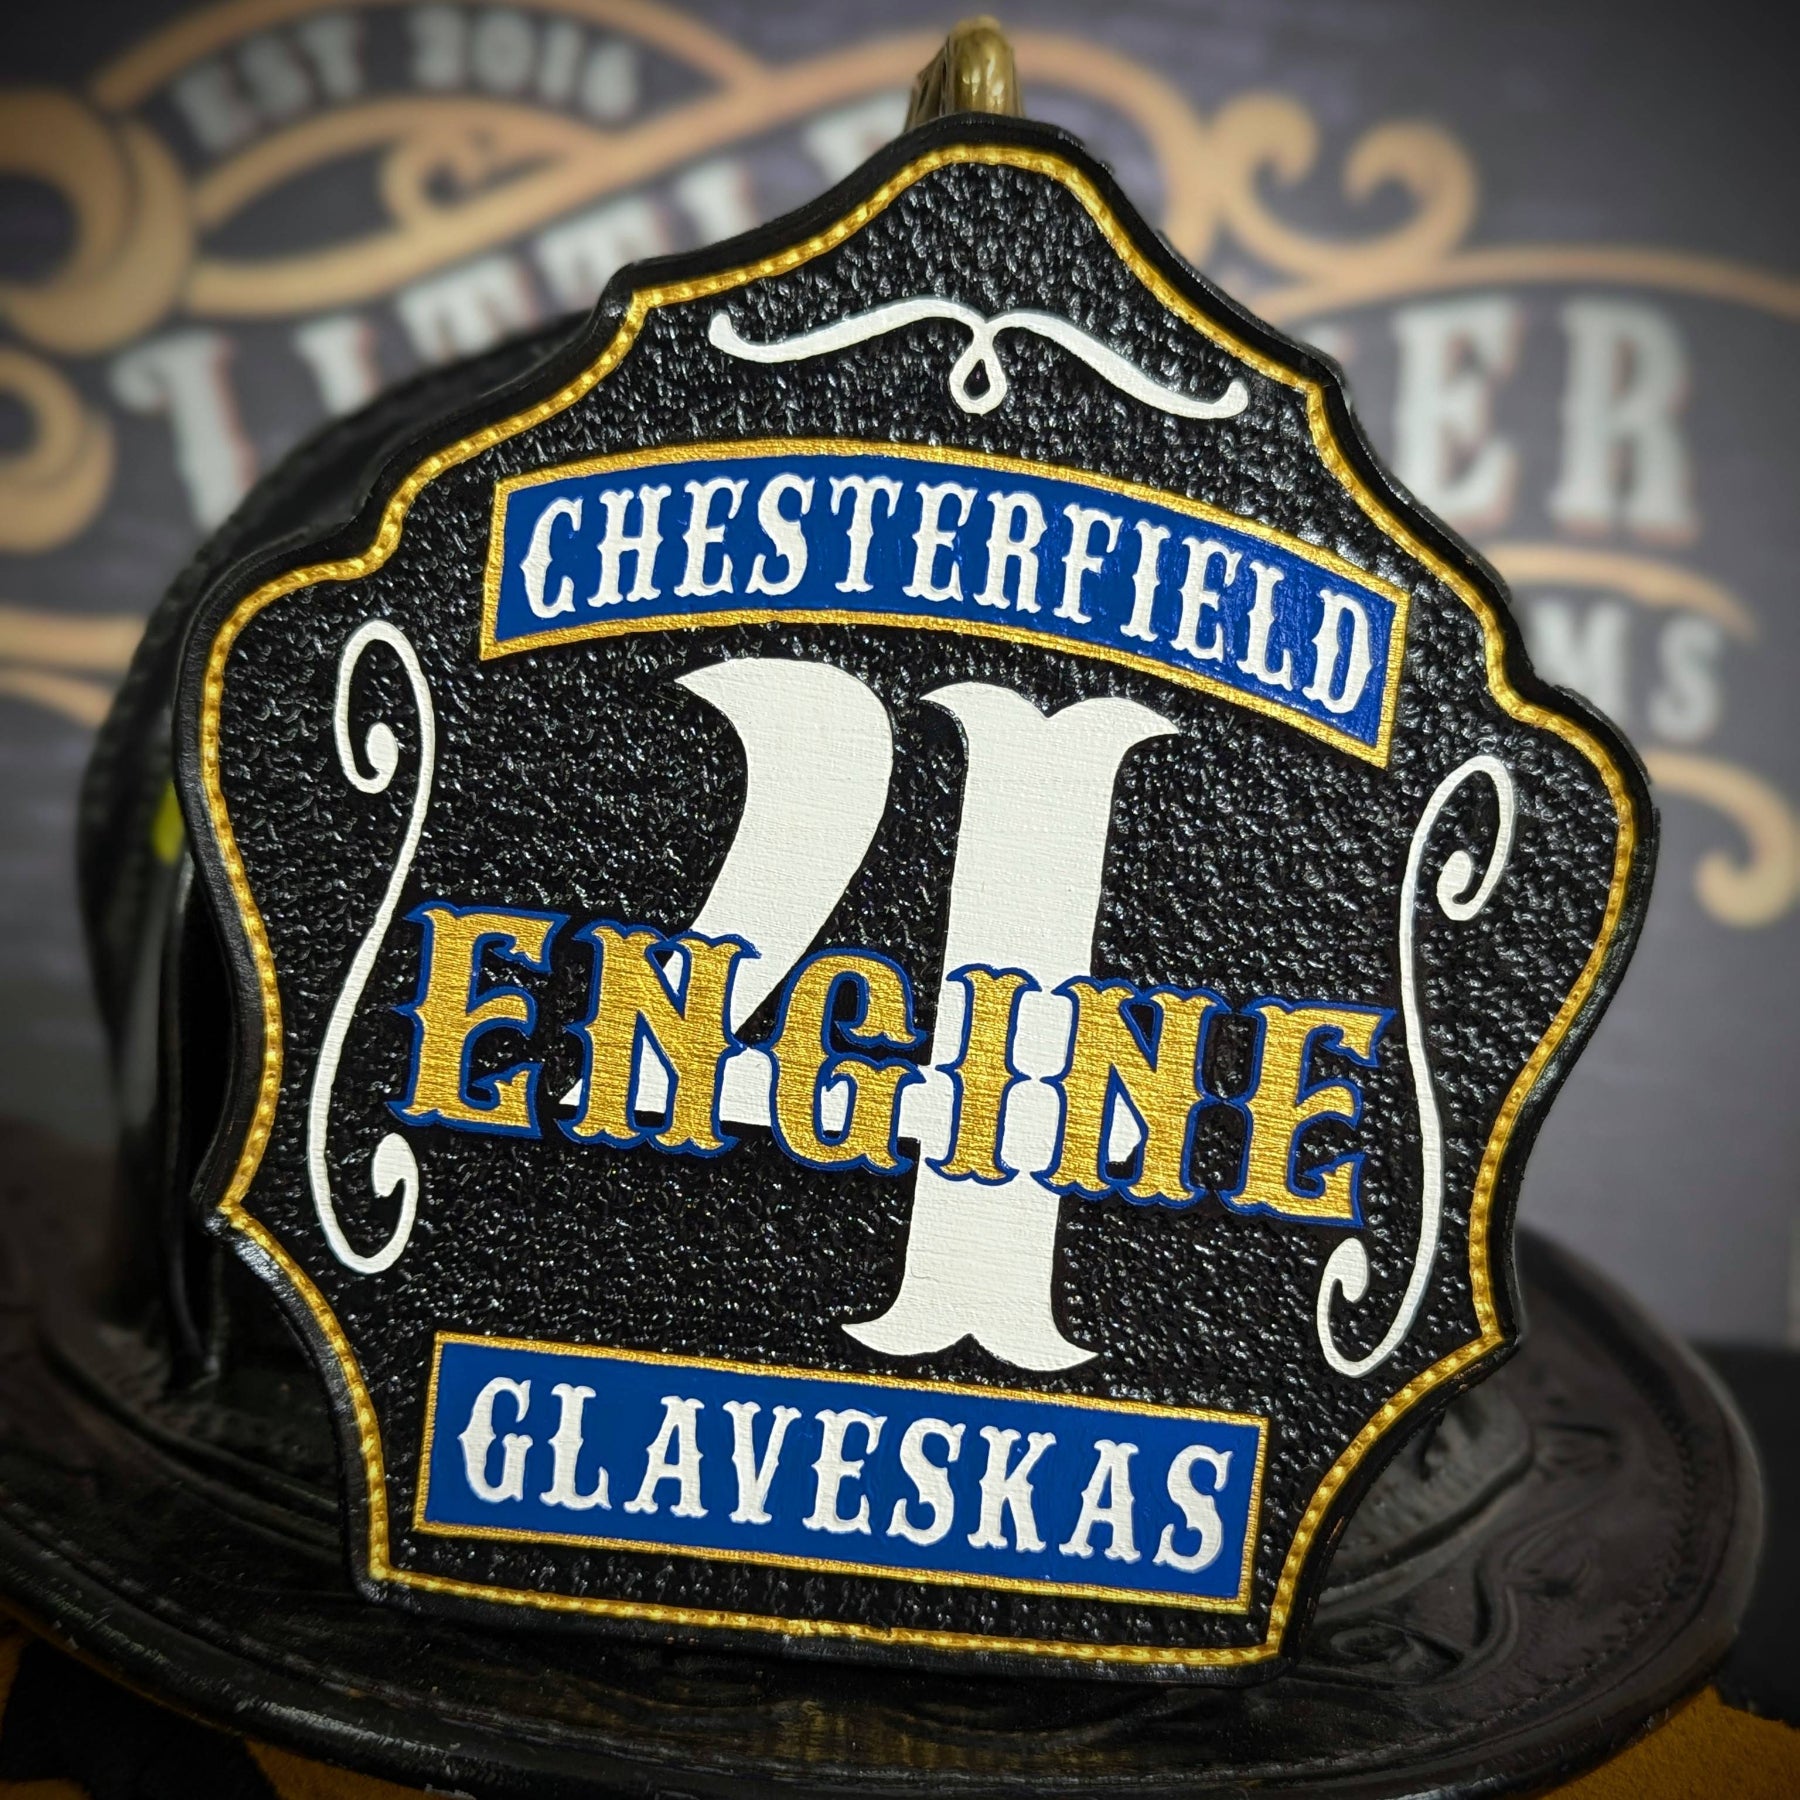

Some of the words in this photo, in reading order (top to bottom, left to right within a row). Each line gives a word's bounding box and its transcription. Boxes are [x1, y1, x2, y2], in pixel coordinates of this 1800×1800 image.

[519, 473, 1374, 715] CHESTERFIELD
[392, 902, 1396, 1226] ENGINE
[558, 656, 1180, 1371] 21
[457, 1376, 1235, 1575] GLAVESKAS
